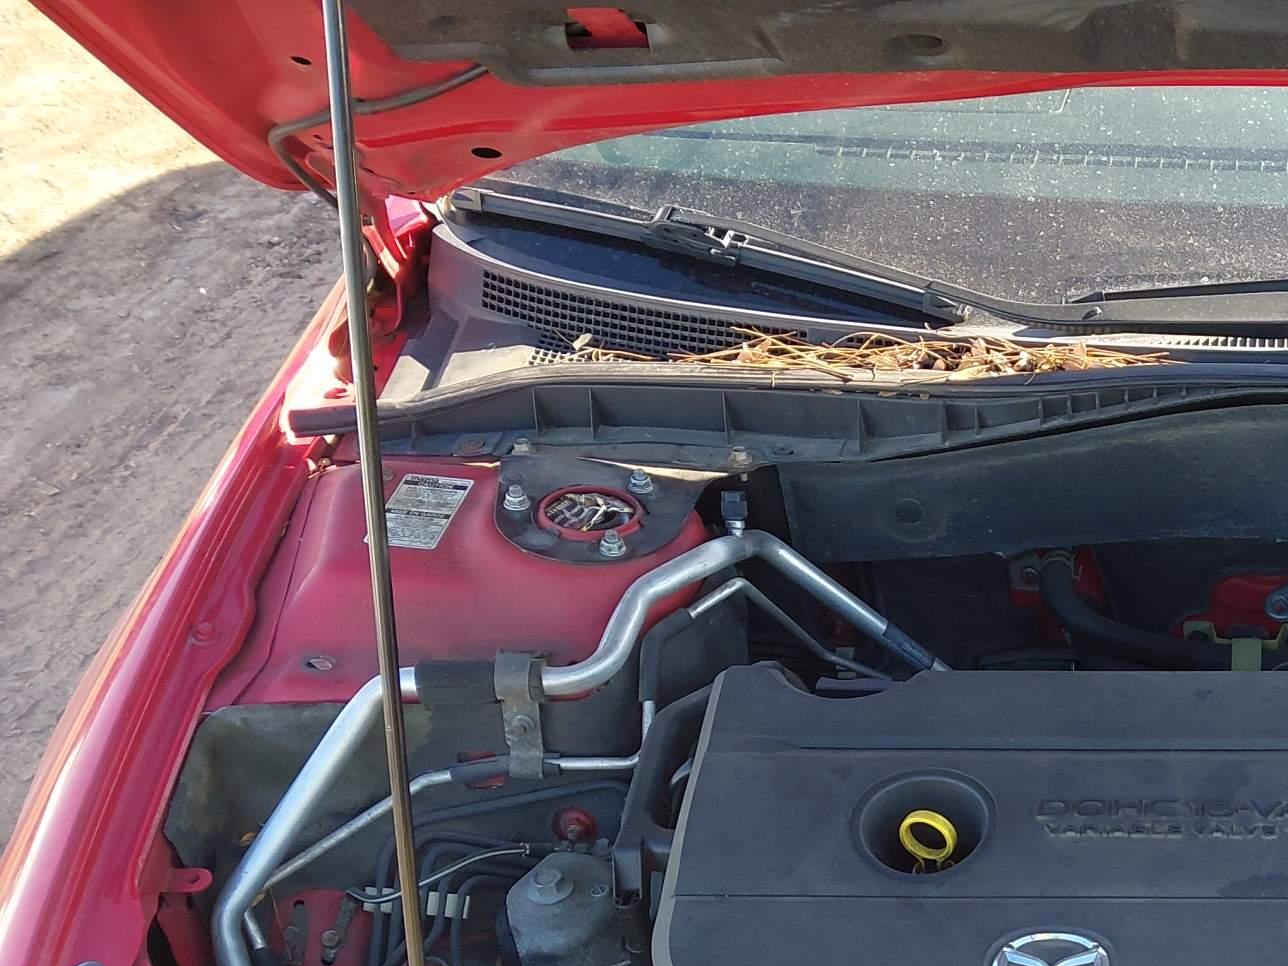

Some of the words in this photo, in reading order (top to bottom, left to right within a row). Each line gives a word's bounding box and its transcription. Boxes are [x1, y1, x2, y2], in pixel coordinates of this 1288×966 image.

[1037, 799, 1179, 819] DOHC
[1044, 823, 1183, 838] VARIABLE
[1194, 823, 1279, 839] VALVE
